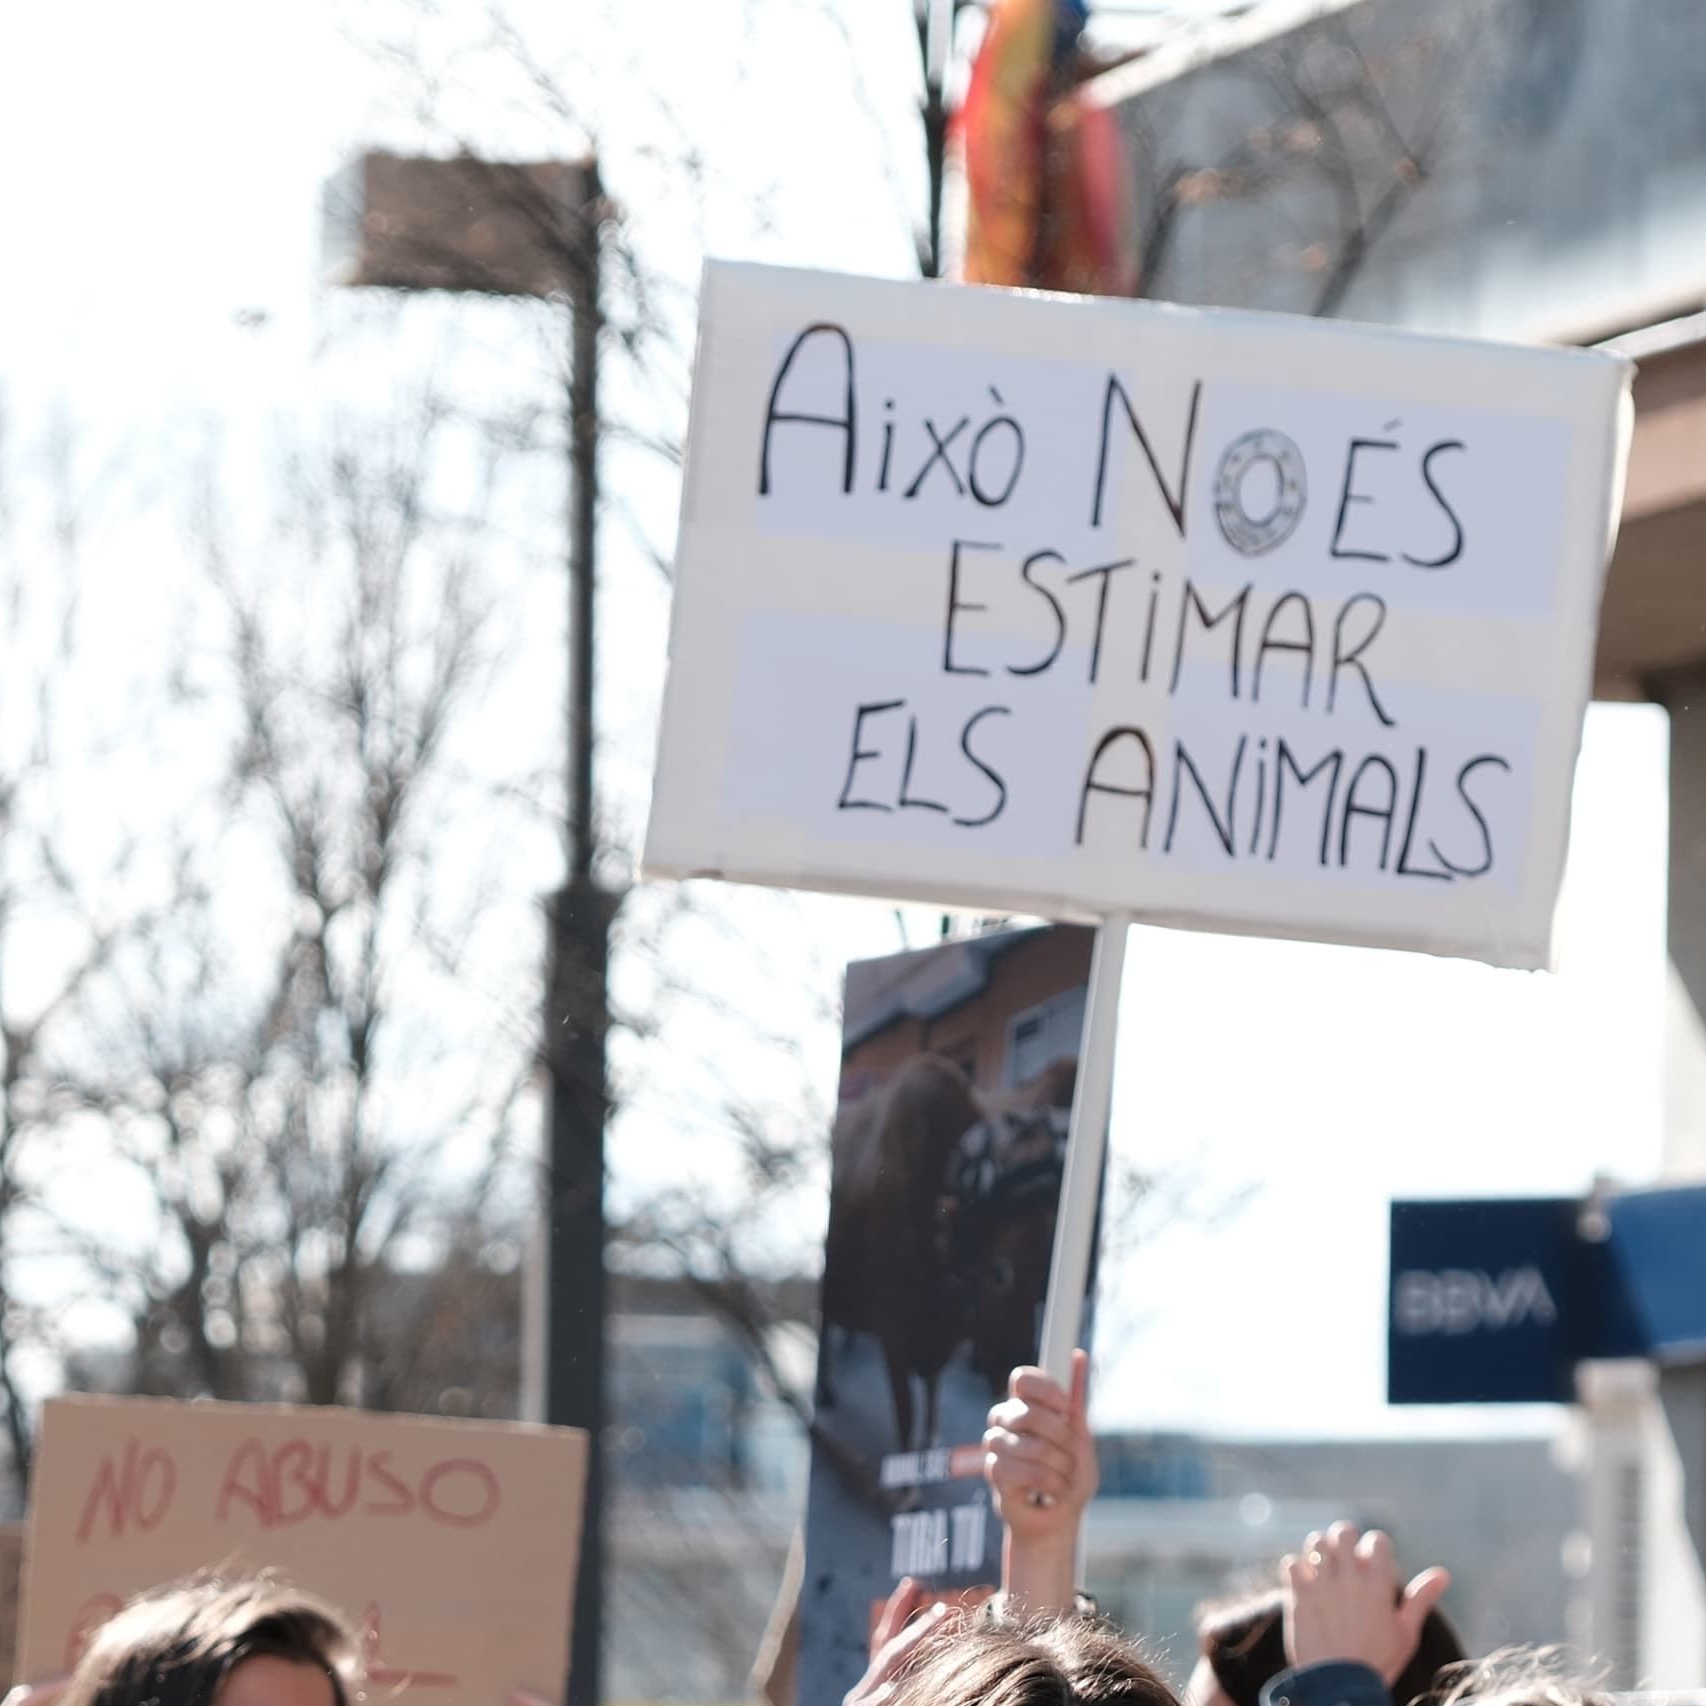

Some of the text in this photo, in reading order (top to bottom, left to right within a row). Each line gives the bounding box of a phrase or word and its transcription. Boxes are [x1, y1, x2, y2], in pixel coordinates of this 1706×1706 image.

[759, 322, 1025, 508] Això
[1330, 419, 1466, 568] ÉS
[838, 700, 1015, 828] ELS
[1395, 1266, 1558, 1335] BBVA
[75, 1436, 501, 1545] NO ABUSO
